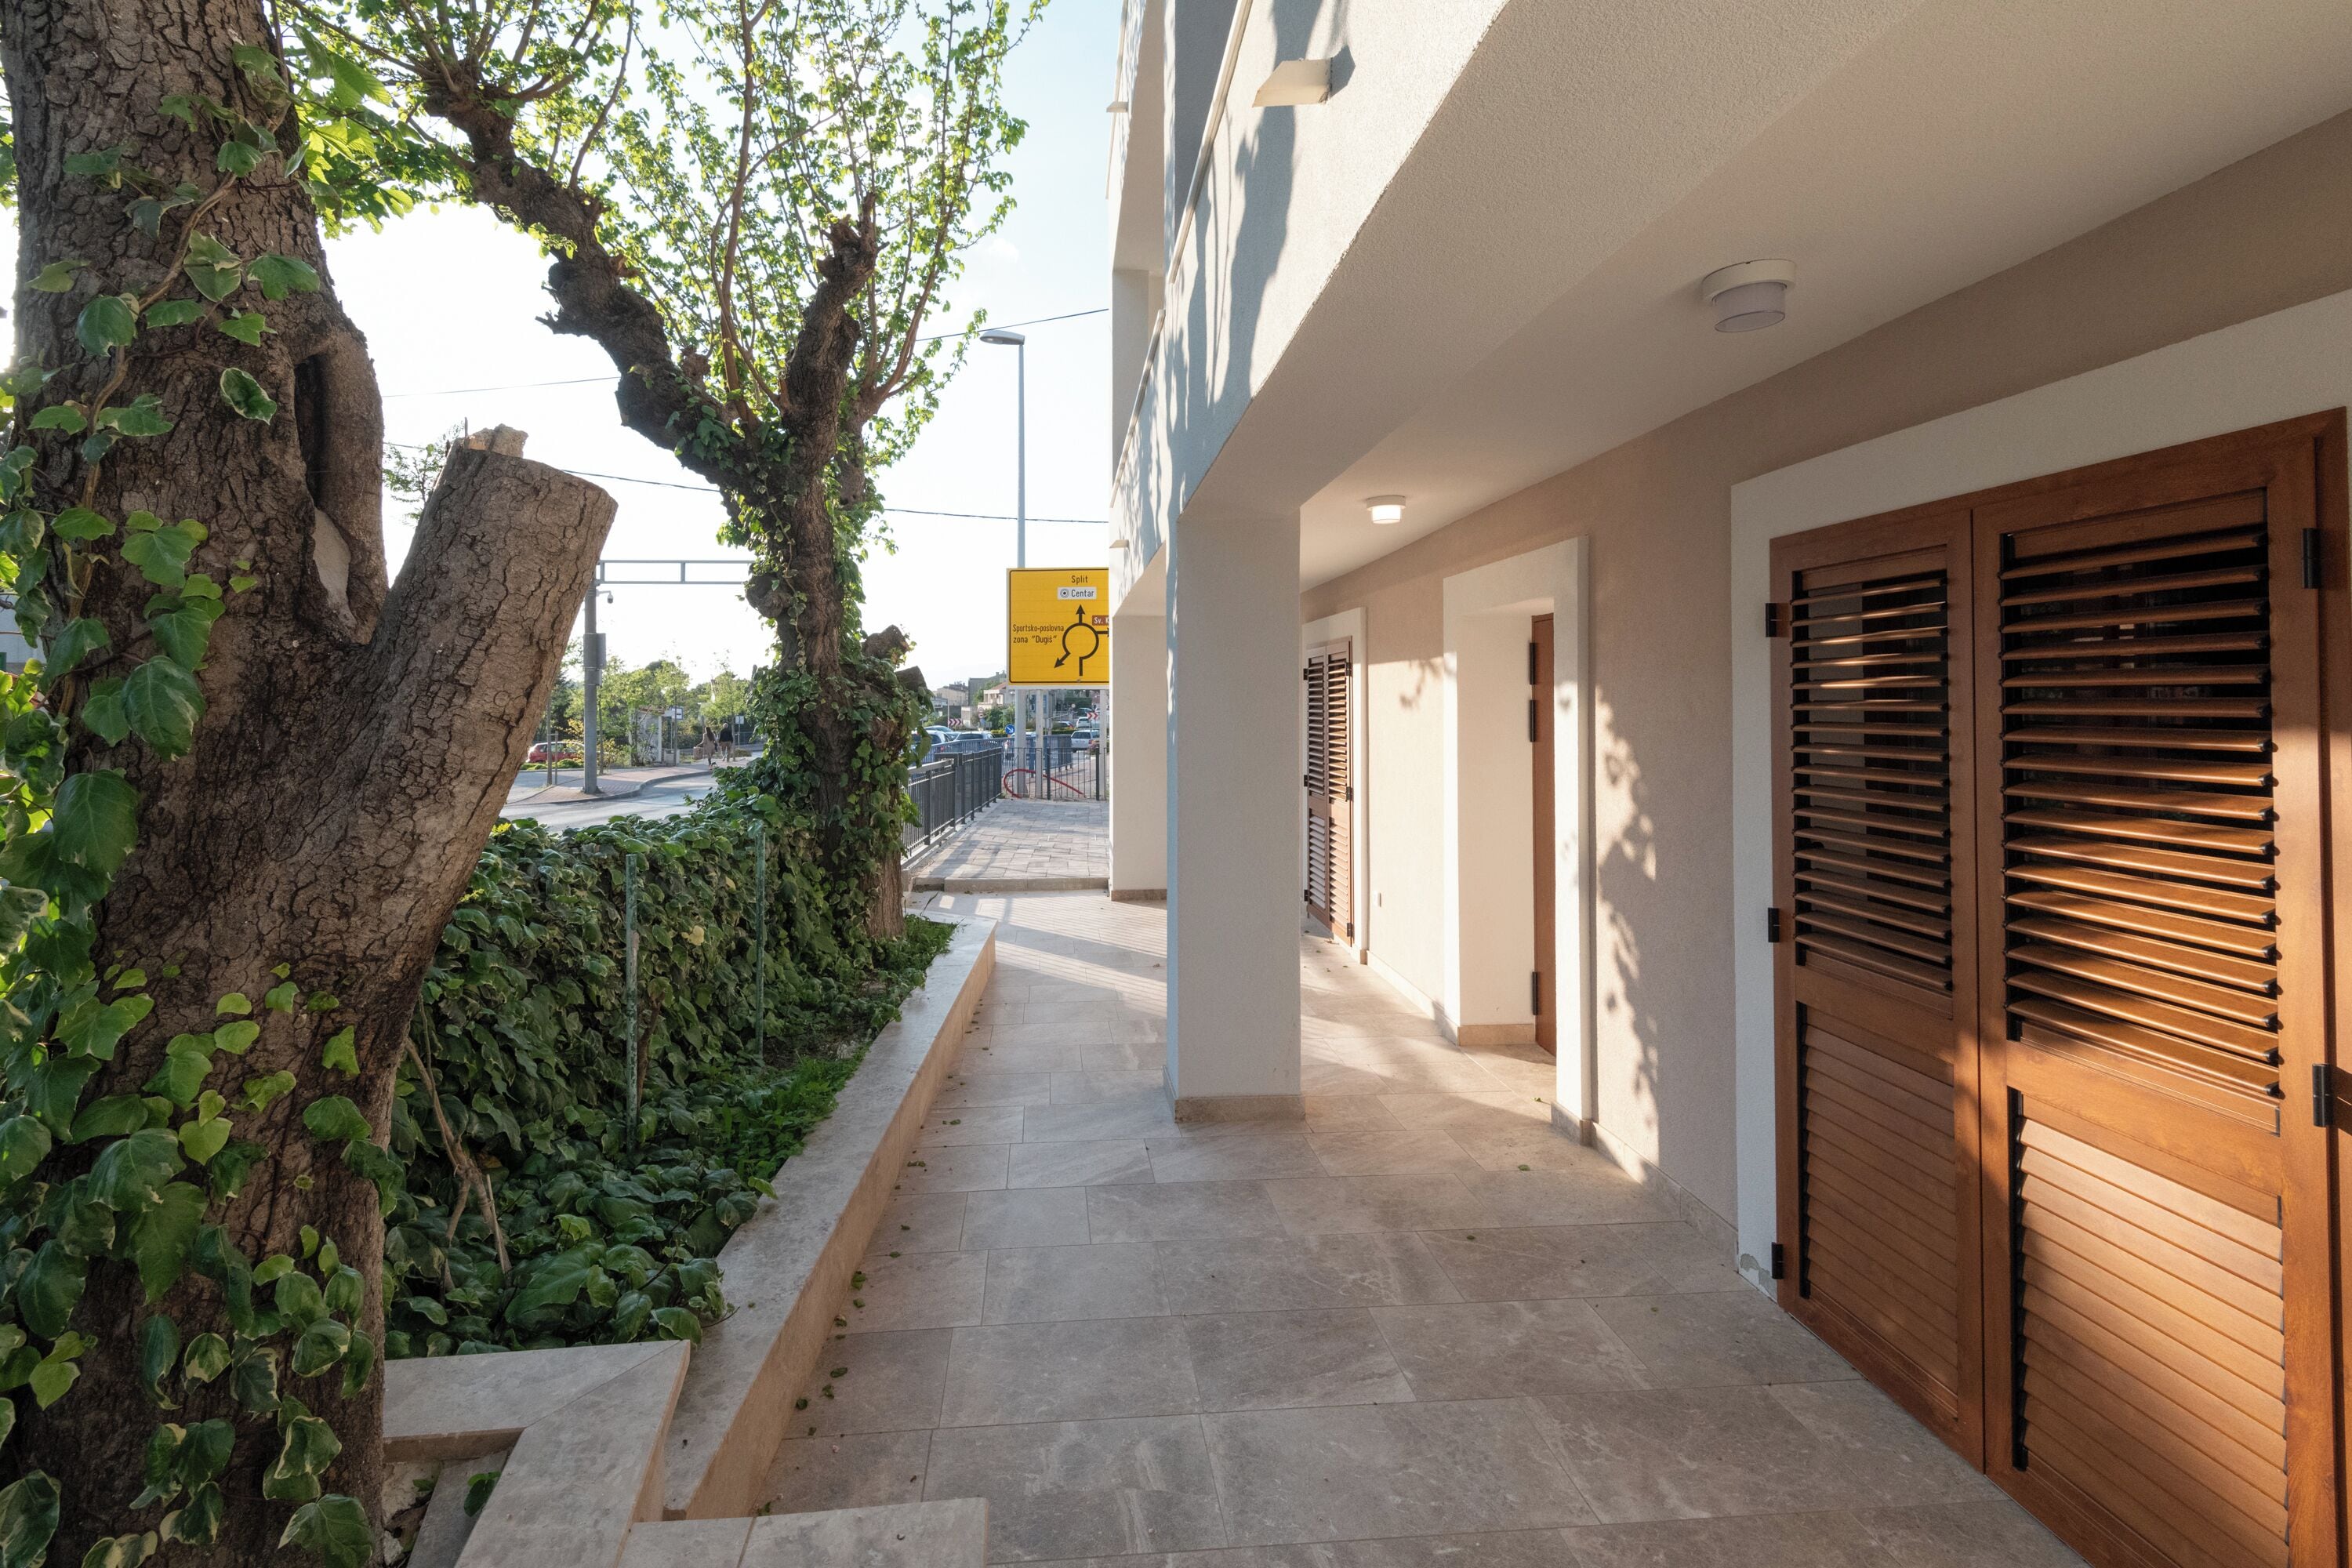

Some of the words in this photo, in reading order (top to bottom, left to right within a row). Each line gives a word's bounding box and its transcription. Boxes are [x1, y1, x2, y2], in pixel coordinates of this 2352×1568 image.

[1071, 575, 1088, 585] Split
[1071, 589, 1094, 597] Centar
[1012, 624, 1064, 633] Sportsko-poslovna
